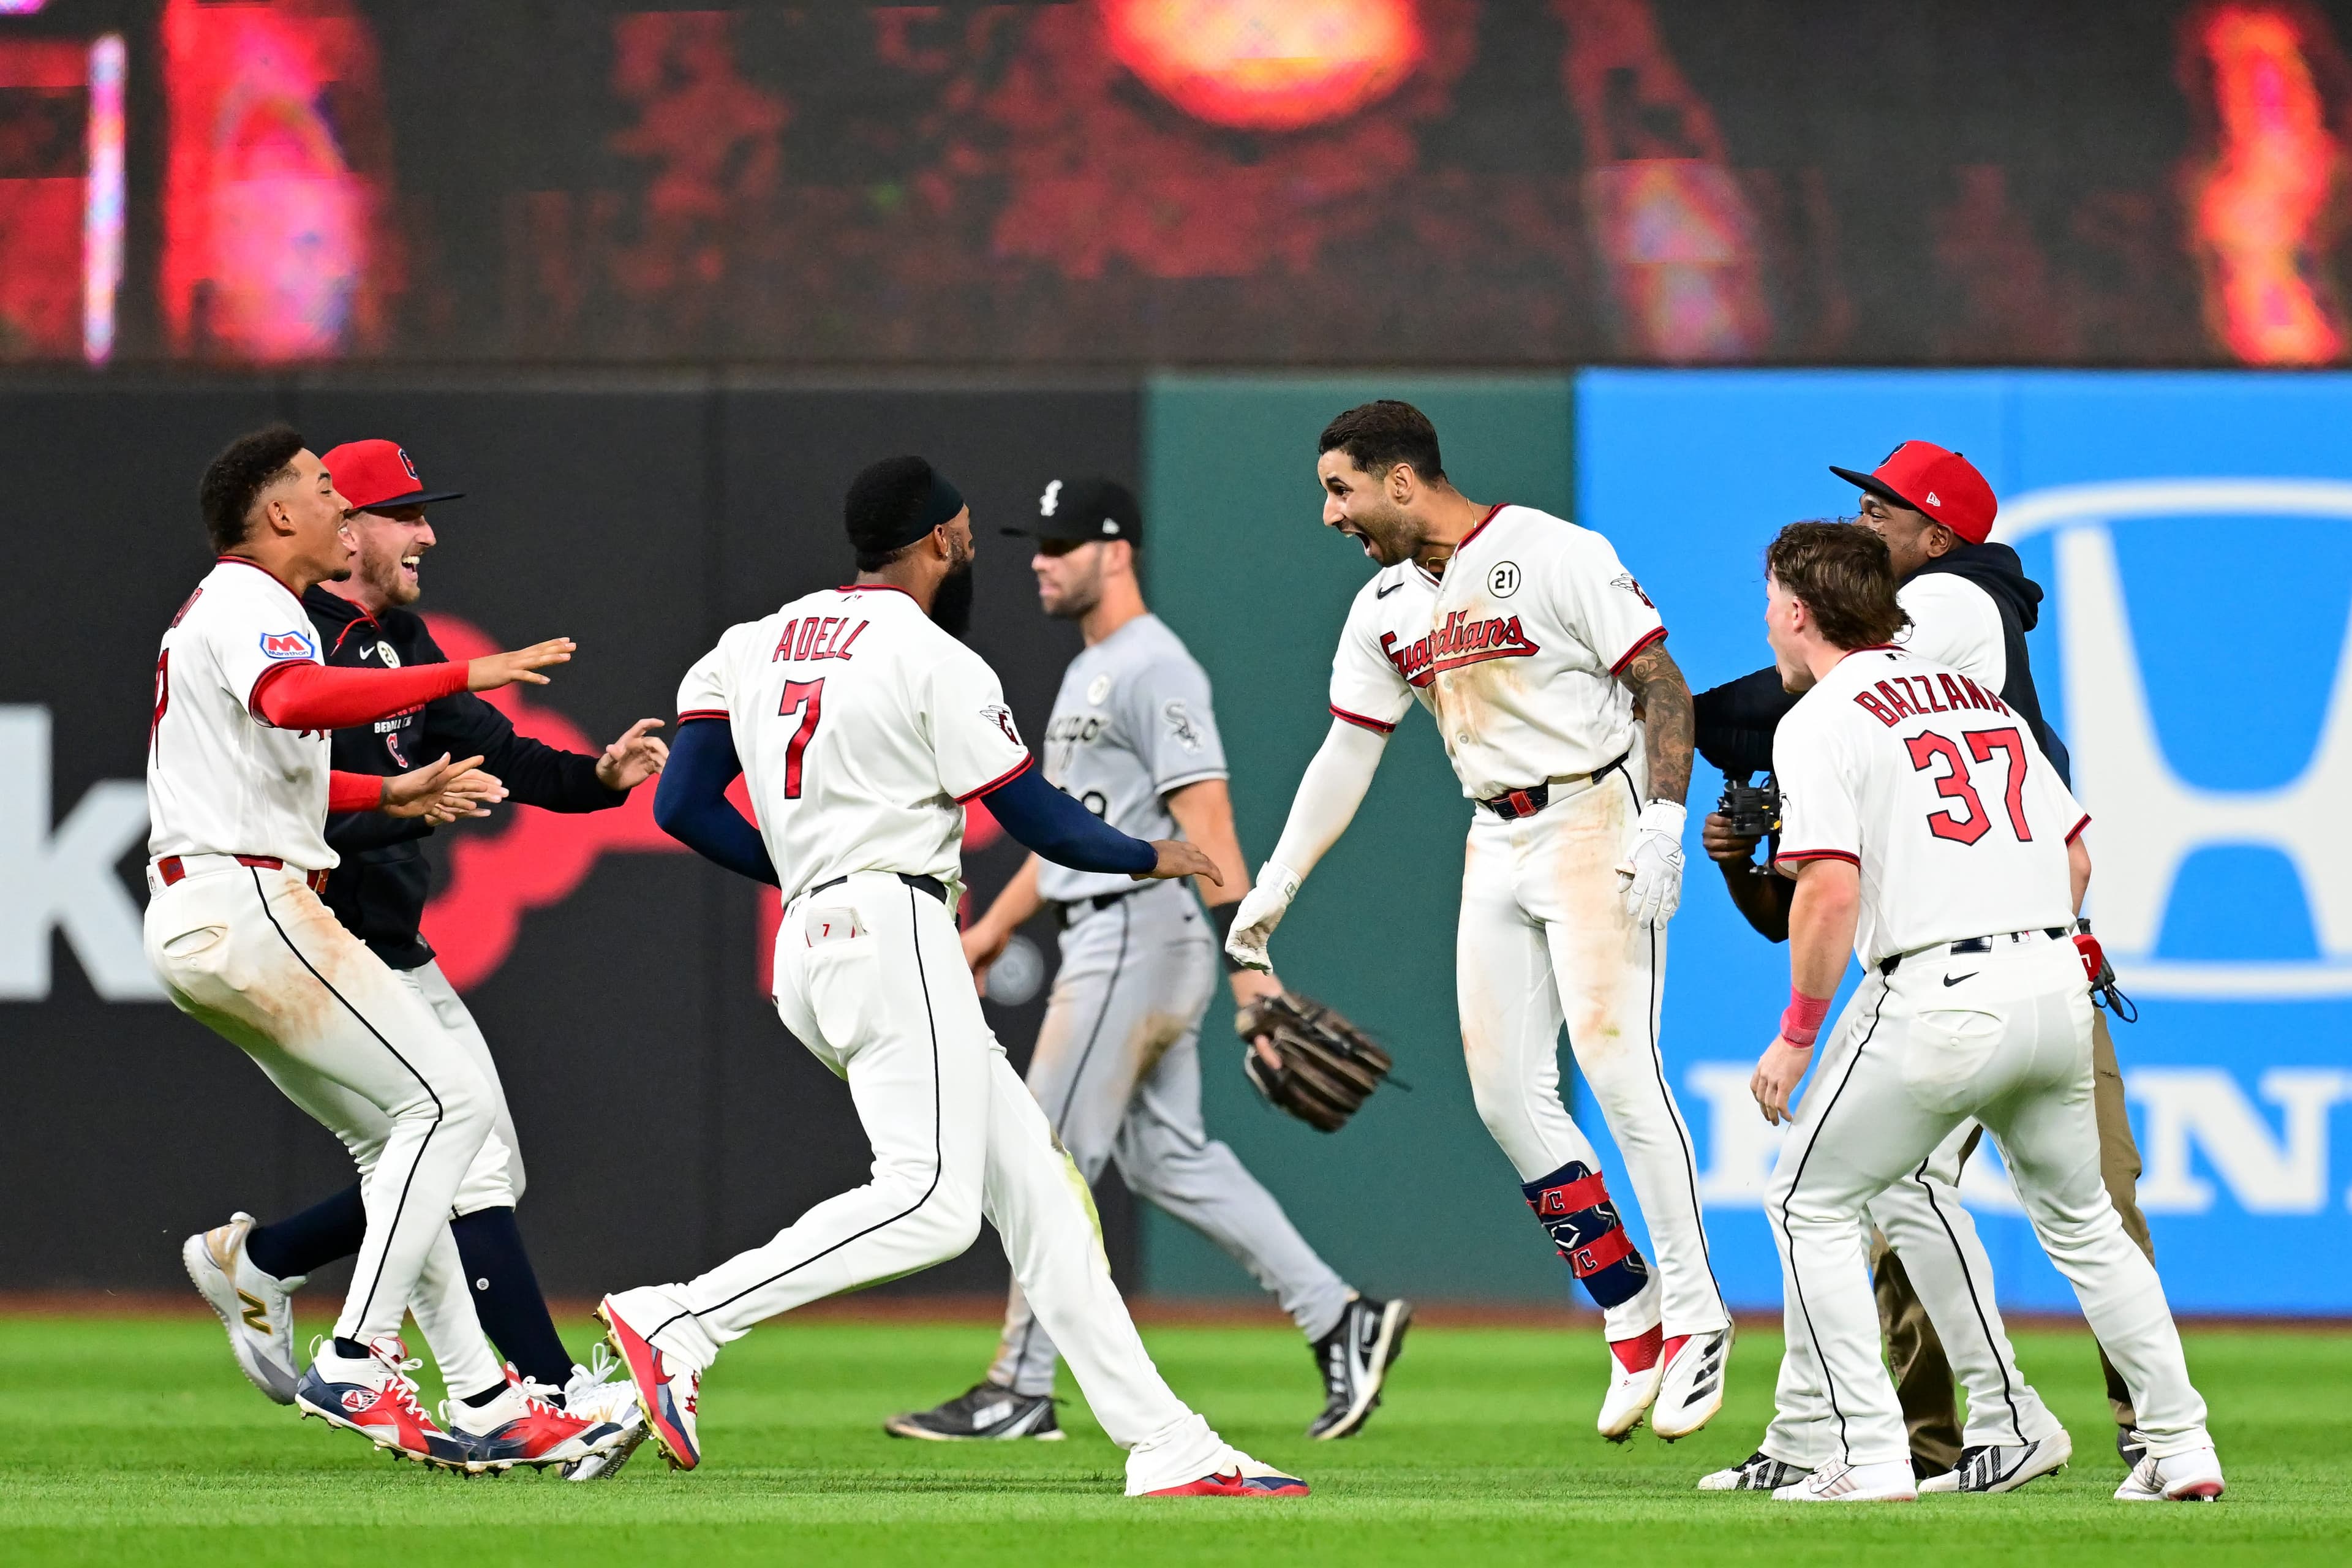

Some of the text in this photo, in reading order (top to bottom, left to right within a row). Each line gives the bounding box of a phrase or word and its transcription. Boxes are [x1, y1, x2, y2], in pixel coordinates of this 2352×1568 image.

[1494, 569, 1513, 589] 21
[381, 647, 397, 664] 21
[772, 617, 870, 663] ADELL
[1379, 609, 1541, 688] Guardians
[1853, 673, 2011, 728] BAZZANA
[386, 733, 409, 769] C
[777, 676, 826, 800] 7
[1903, 726, 2034, 846] 37
[823, 923, 831, 937] 7
[1547, 1190, 1566, 1212] C
[1577, 1248, 1598, 1270] C
